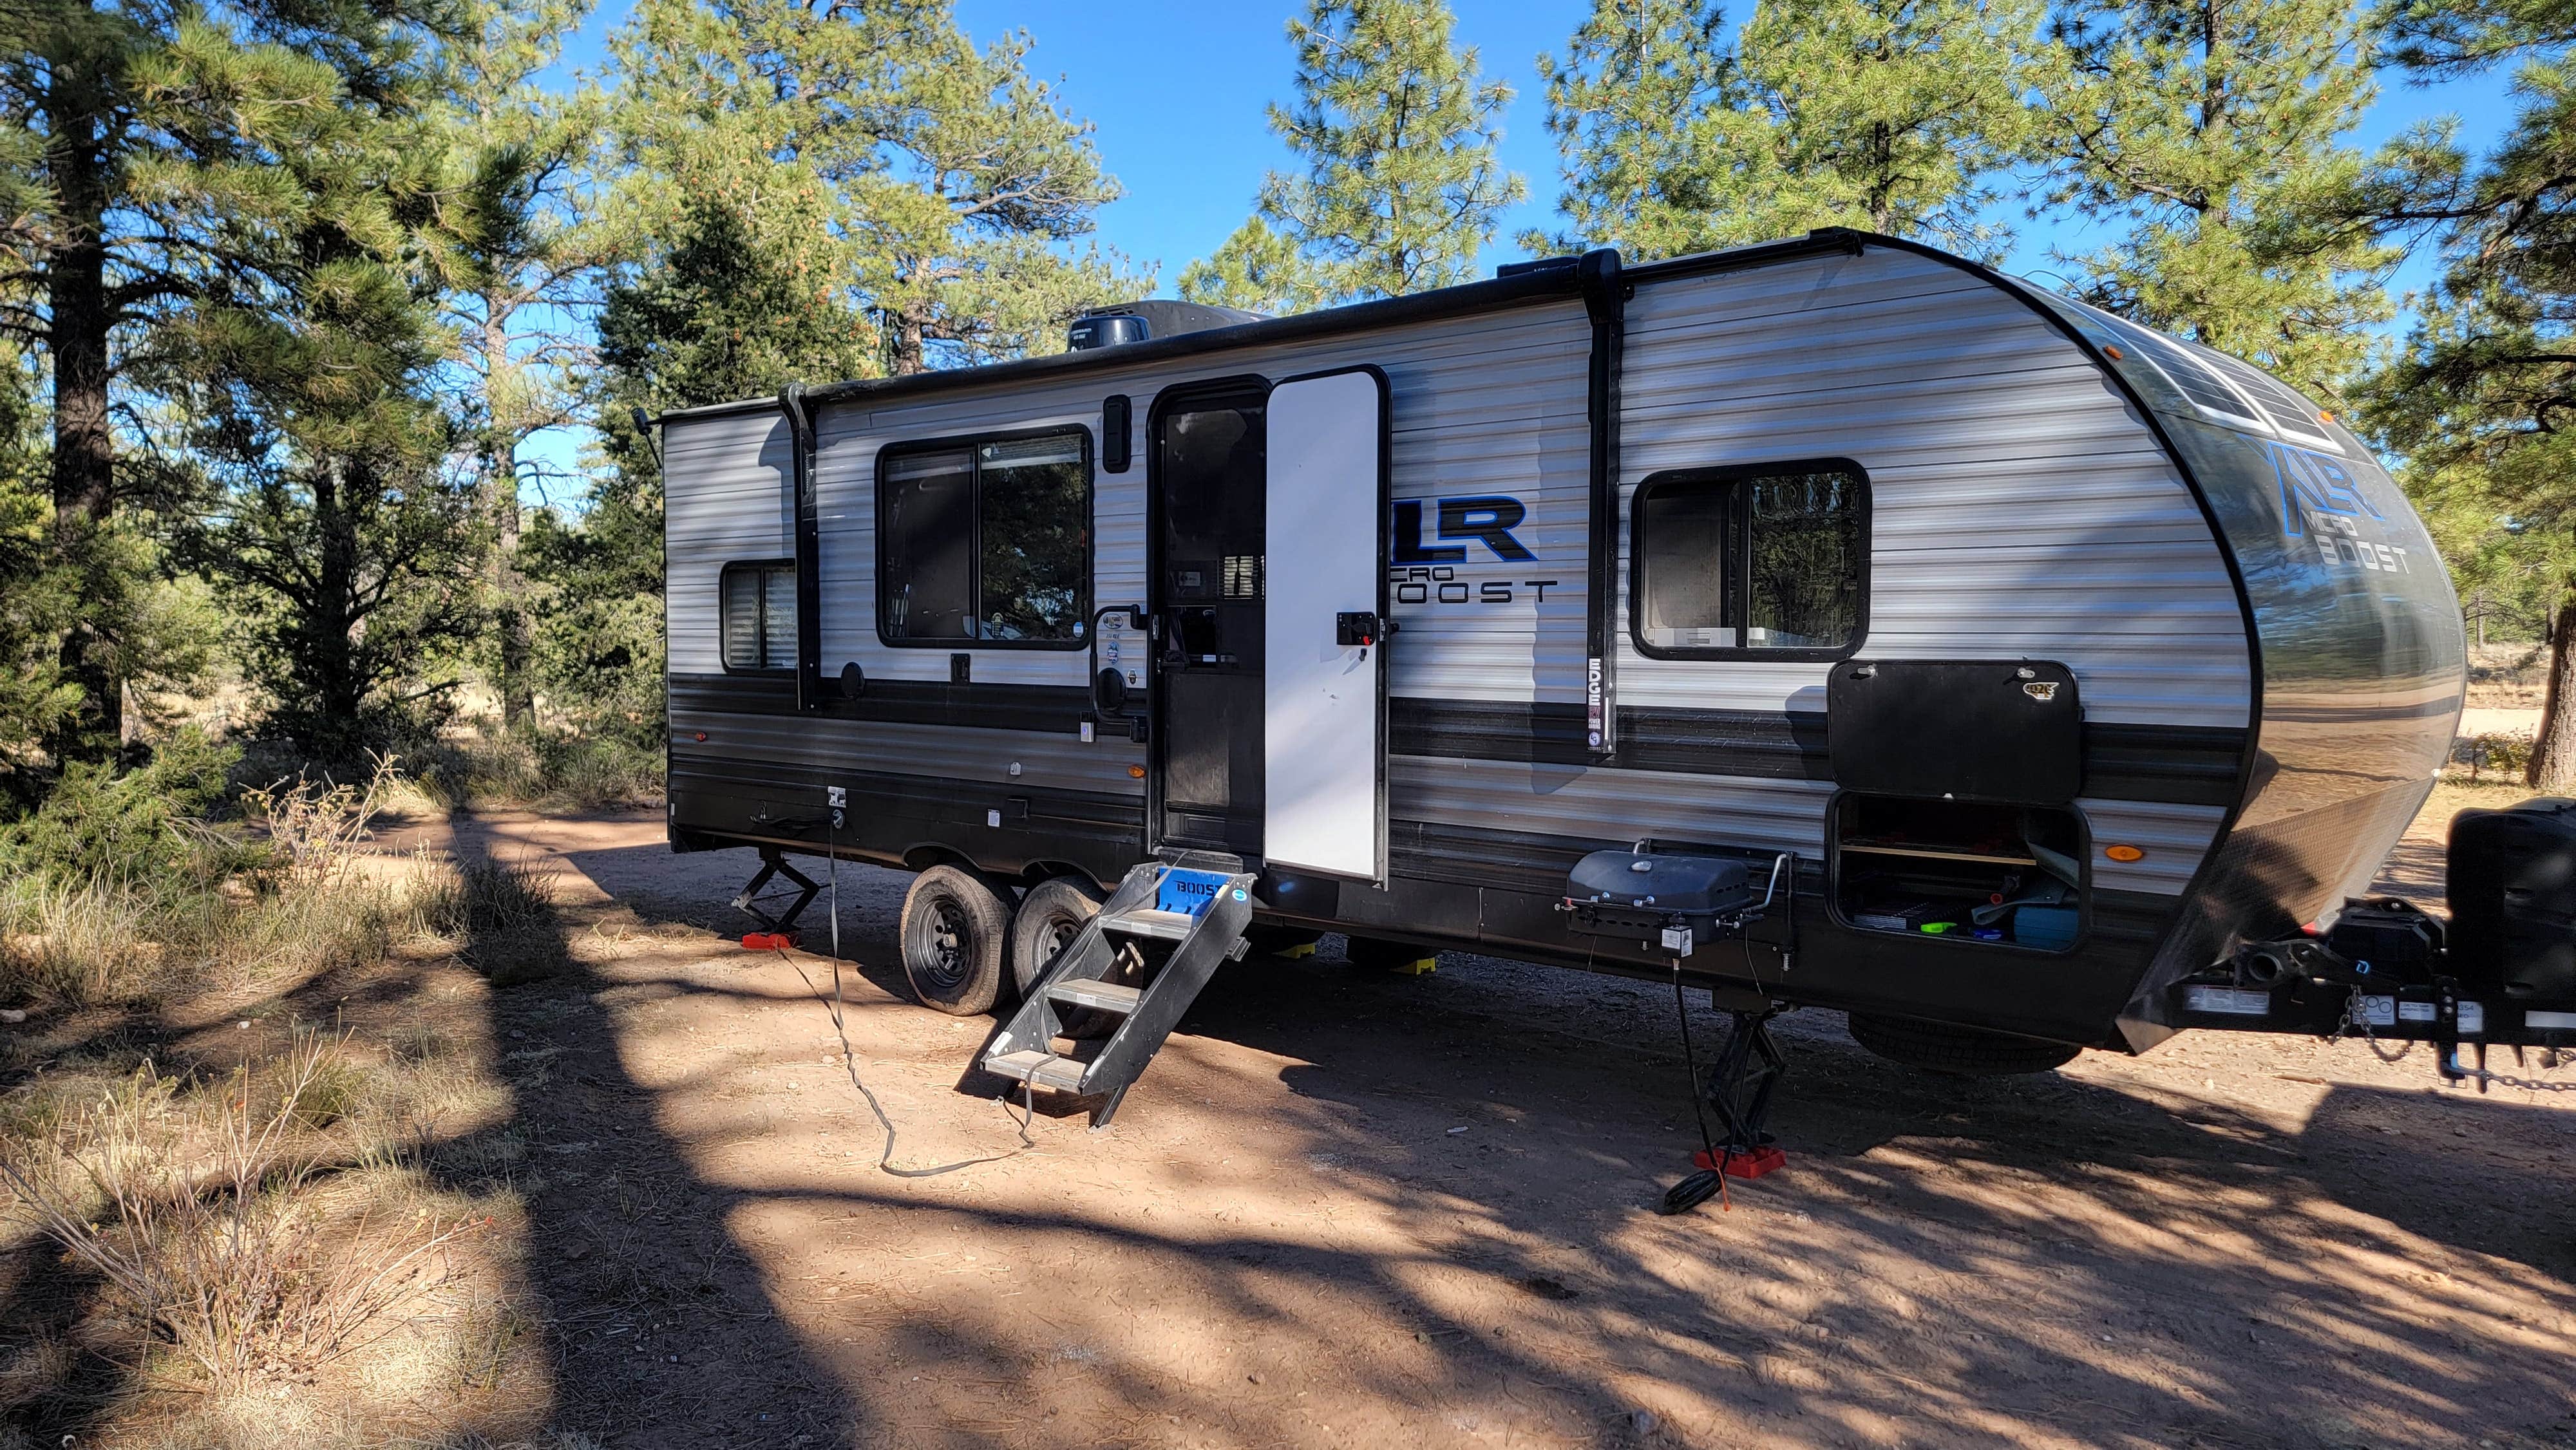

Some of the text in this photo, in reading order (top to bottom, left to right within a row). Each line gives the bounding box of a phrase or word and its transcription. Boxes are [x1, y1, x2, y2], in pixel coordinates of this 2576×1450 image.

[2302, 510, 2358, 536] MICRO
[2314, 535, 2410, 574] BOOST
[1398, 581, 1557, 603] OOST
[1588, 658, 1601, 706] EDGE
